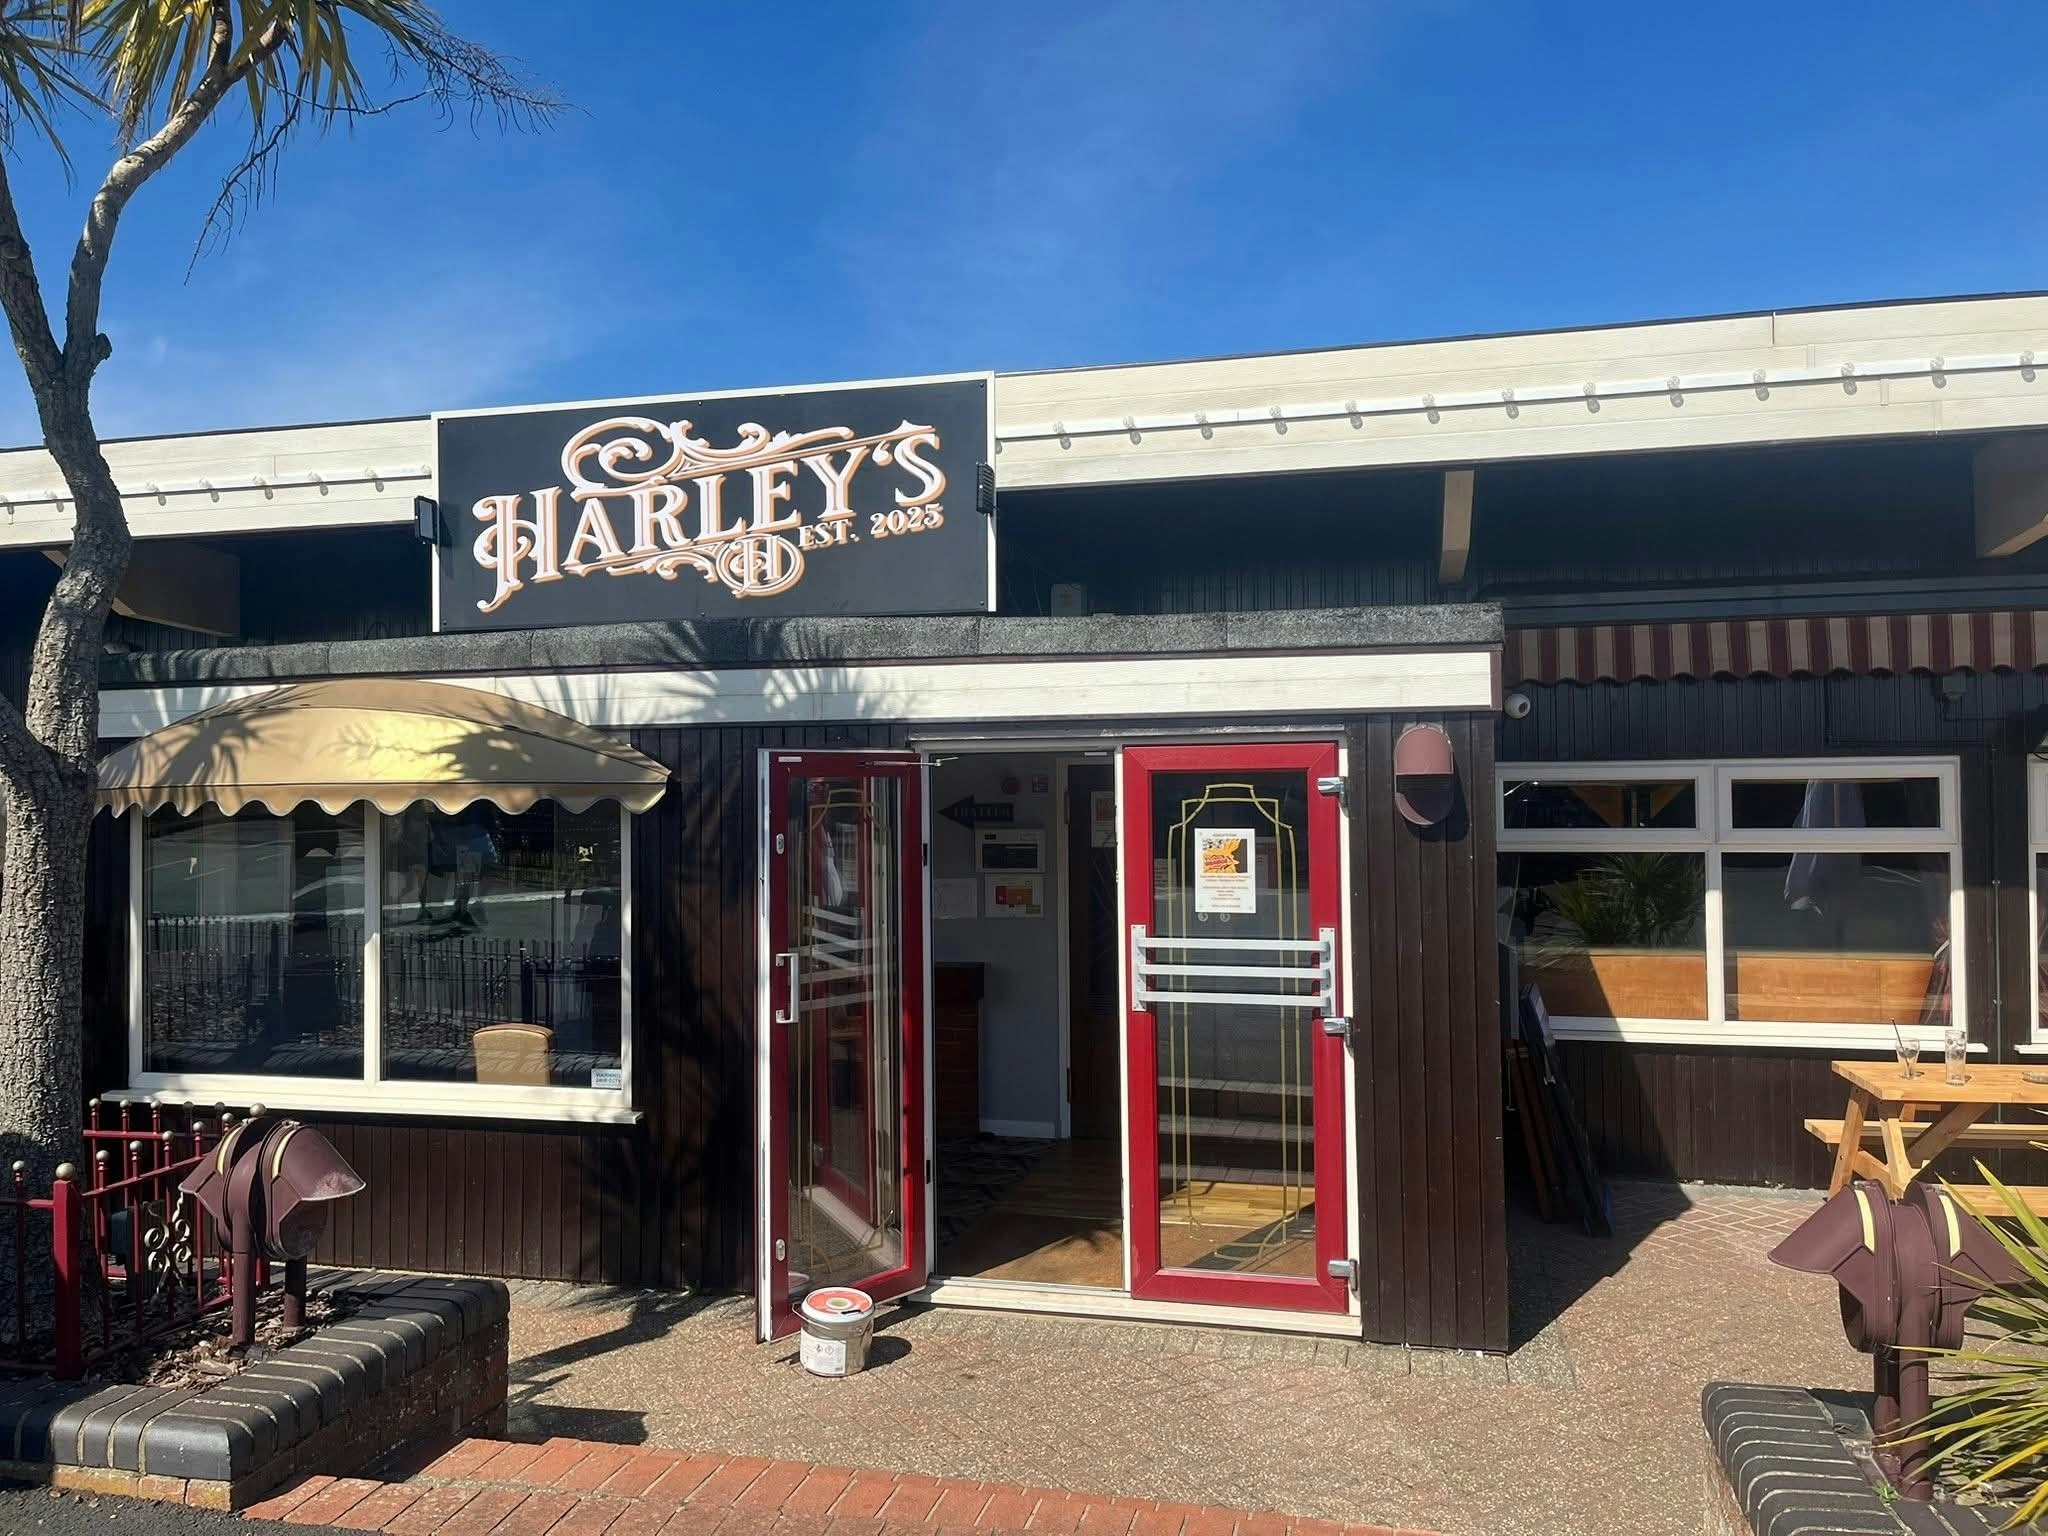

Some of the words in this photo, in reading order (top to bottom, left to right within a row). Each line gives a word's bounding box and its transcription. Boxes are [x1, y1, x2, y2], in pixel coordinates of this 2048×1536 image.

[472, 431, 947, 613] HARLEY'S
[798, 518, 860, 551] EST.
[870, 503, 944, 539] 2025
